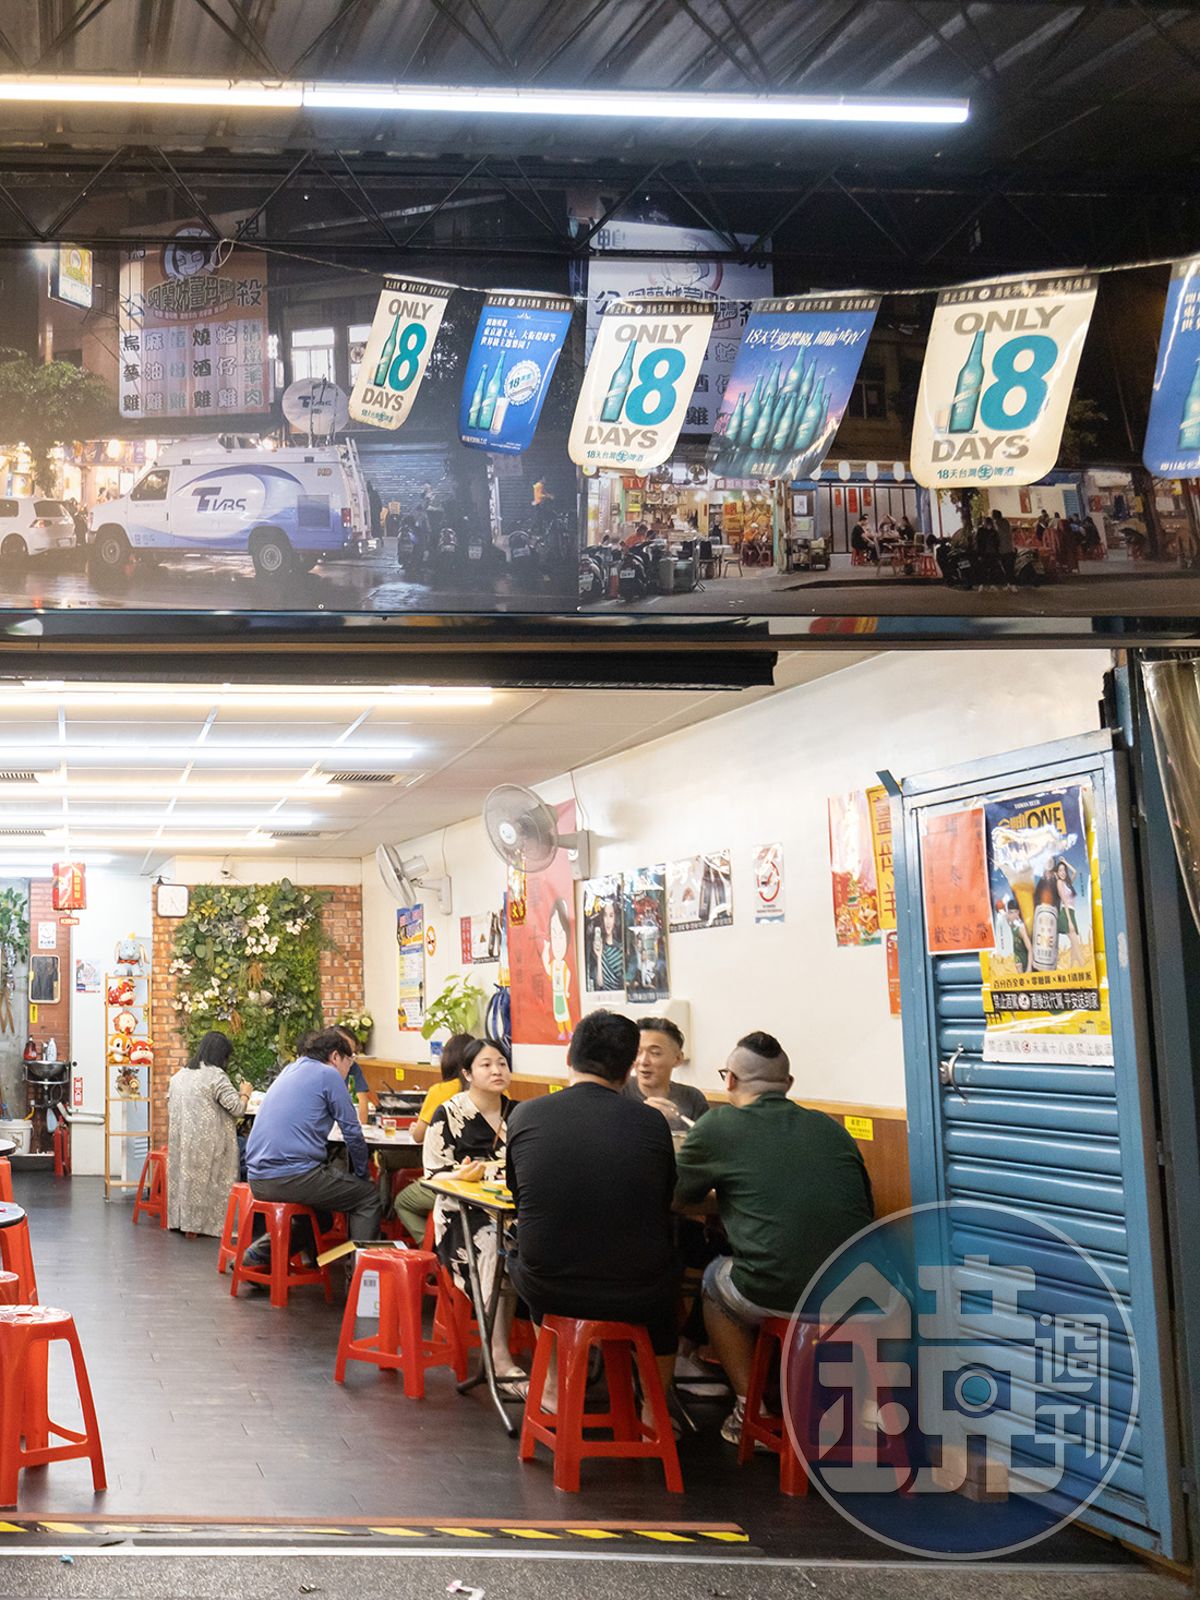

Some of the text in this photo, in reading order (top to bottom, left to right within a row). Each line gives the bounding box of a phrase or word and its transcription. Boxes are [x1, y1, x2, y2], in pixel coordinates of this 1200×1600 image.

[388, 299, 434, 320] ONLY
[954, 305, 1064, 335] ONLY
[615, 323, 694, 344] ONLY
[361, 389, 405, 412] DAYS
[584, 426, 658, 449] DAYS
[931, 435, 1030, 463] DAYS
